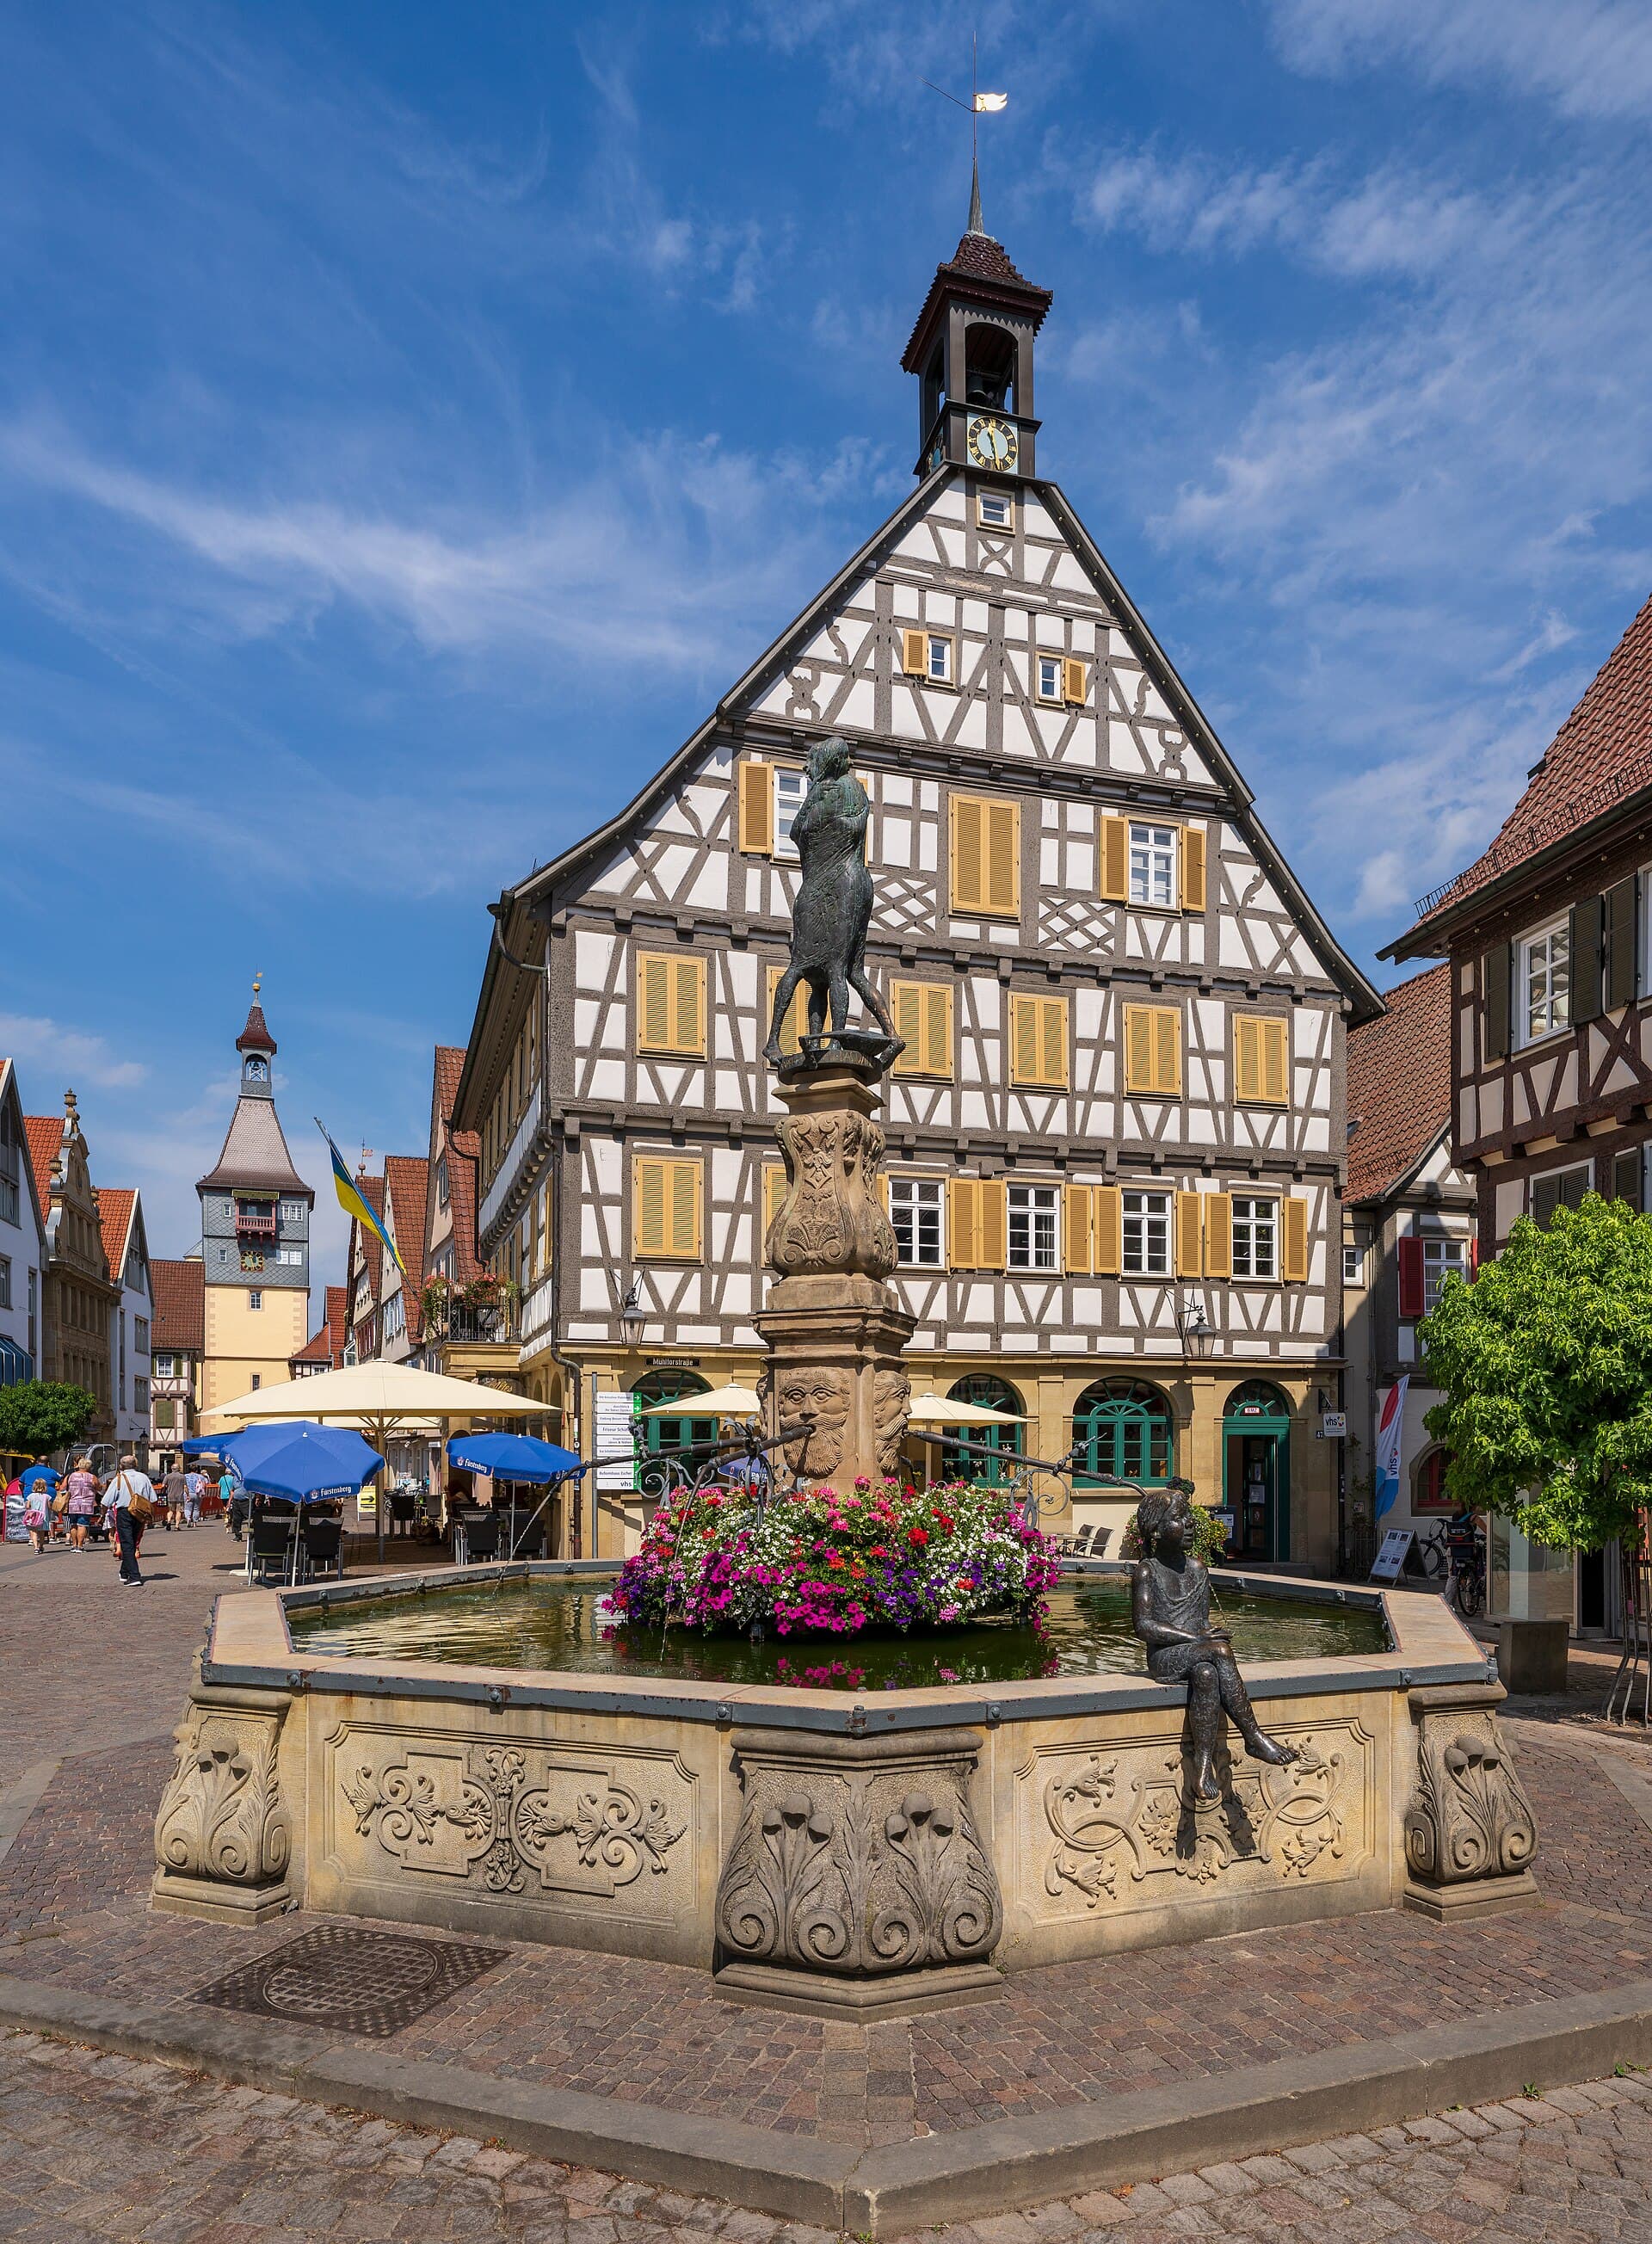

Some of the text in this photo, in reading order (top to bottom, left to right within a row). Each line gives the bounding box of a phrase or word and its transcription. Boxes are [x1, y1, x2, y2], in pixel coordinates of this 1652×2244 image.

[652, 1358, 693, 1366] Mühltorstraße
[1325, 1416, 1338, 1426] vhs
[1387, 1458, 1397, 1476] vhs
[320, 1486, 352, 1497] Fürstenberg
